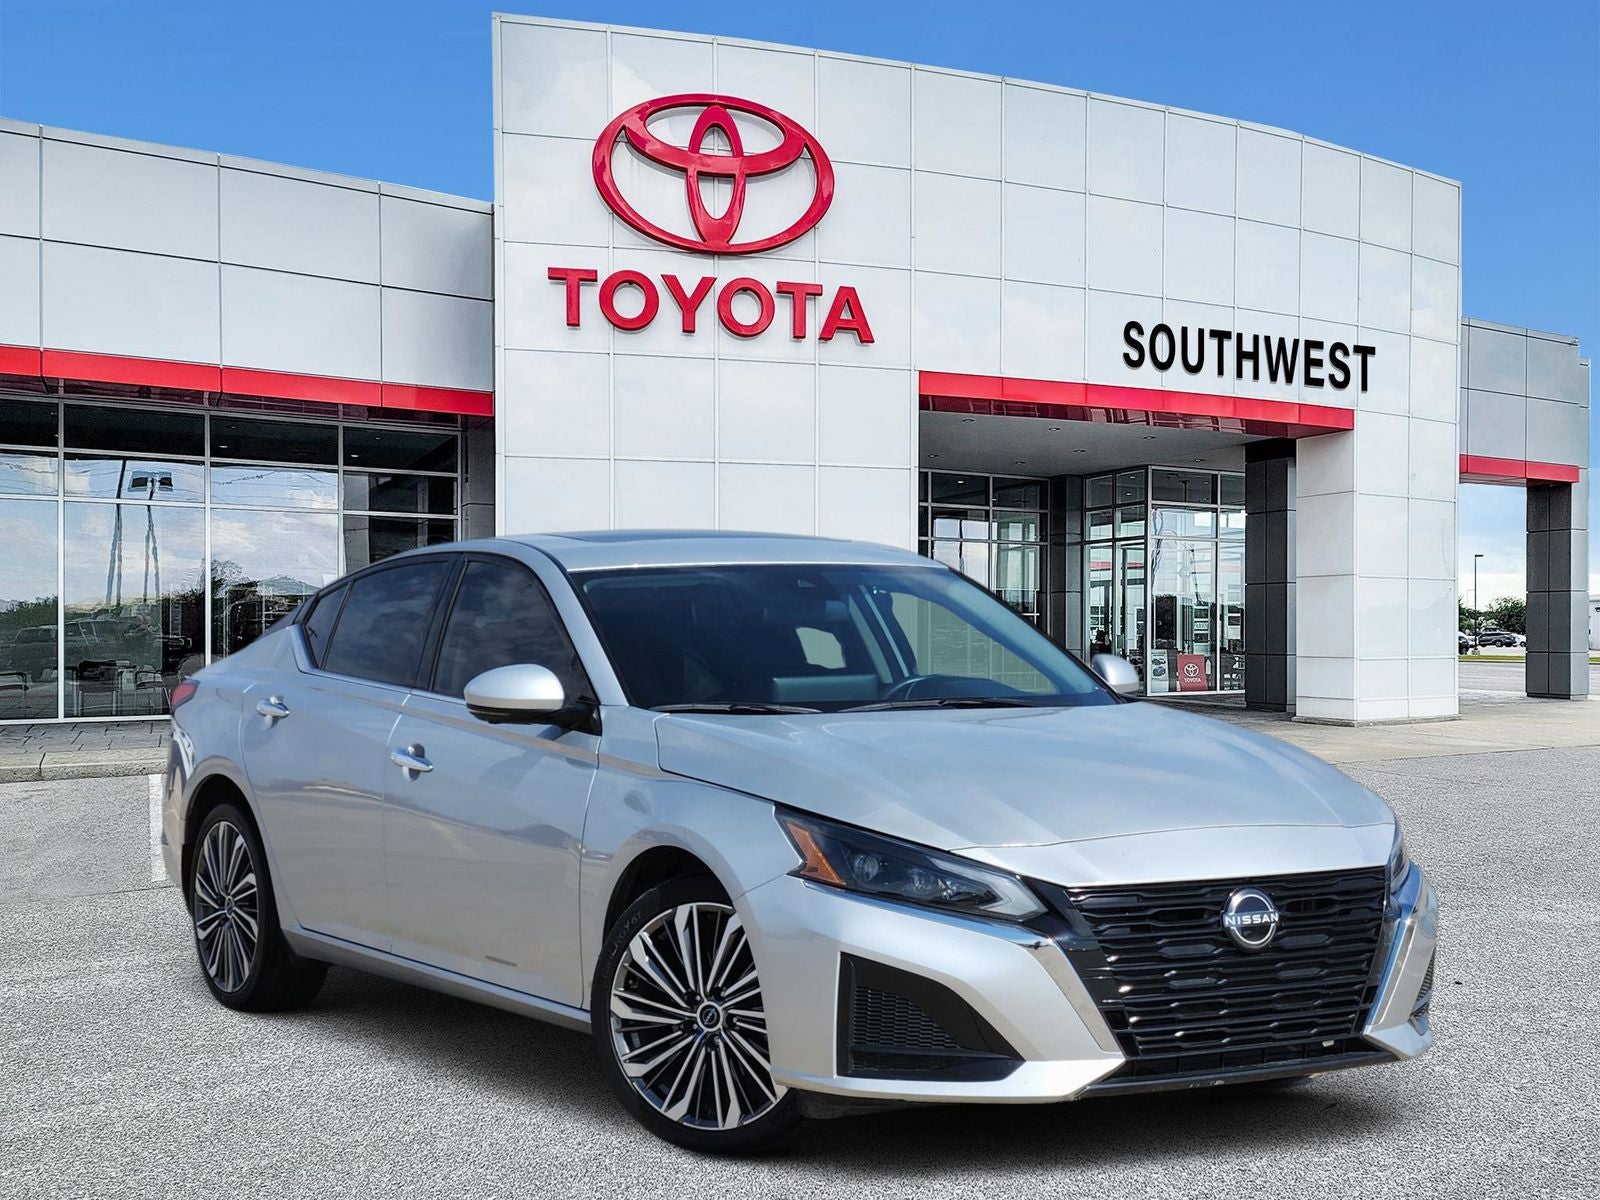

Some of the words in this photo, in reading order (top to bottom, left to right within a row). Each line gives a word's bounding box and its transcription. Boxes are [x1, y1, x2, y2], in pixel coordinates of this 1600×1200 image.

[548, 266, 875, 344] TOYOTA
[1123, 320, 1376, 393] SOUTHWEST
[1225, 912, 1279, 925] NISSAN
